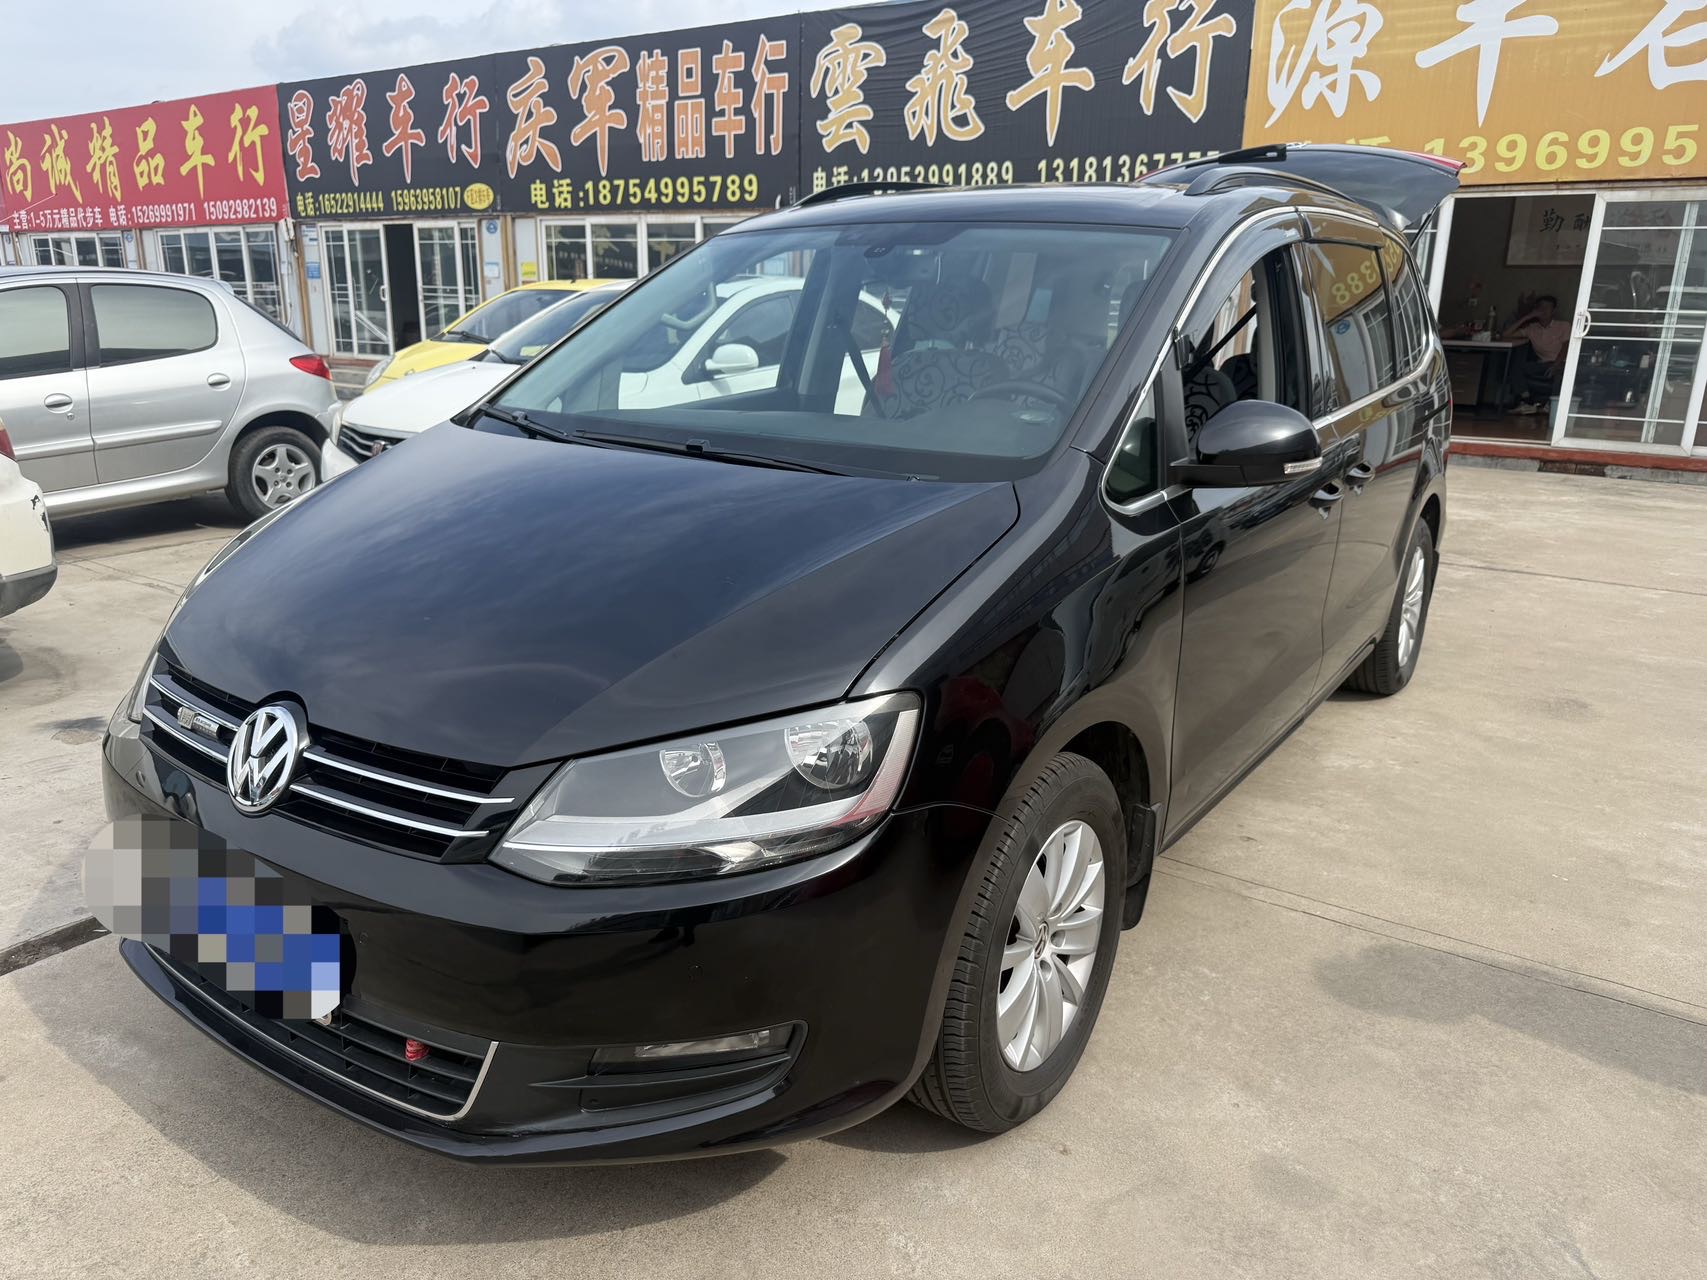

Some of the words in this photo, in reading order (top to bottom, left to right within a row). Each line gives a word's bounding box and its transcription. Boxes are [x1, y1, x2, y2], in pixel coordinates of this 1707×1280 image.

[288, 72, 490, 187] 星耀车行
[4, 103, 269, 203] 尚诚精品车行
[1037, 151, 1220, 183] 13181367
[296, 191, 384, 216] 电话:16522914444
[391, 187, 461, 211] 15963958107
[530, 174, 758, 209] 电话:18754995789
[13, 206, 103, 230] 主营:1-5万元精品代步车
[109, 203, 196, 227] 电话:15269991971
[203, 197, 277, 220] 15092982139
